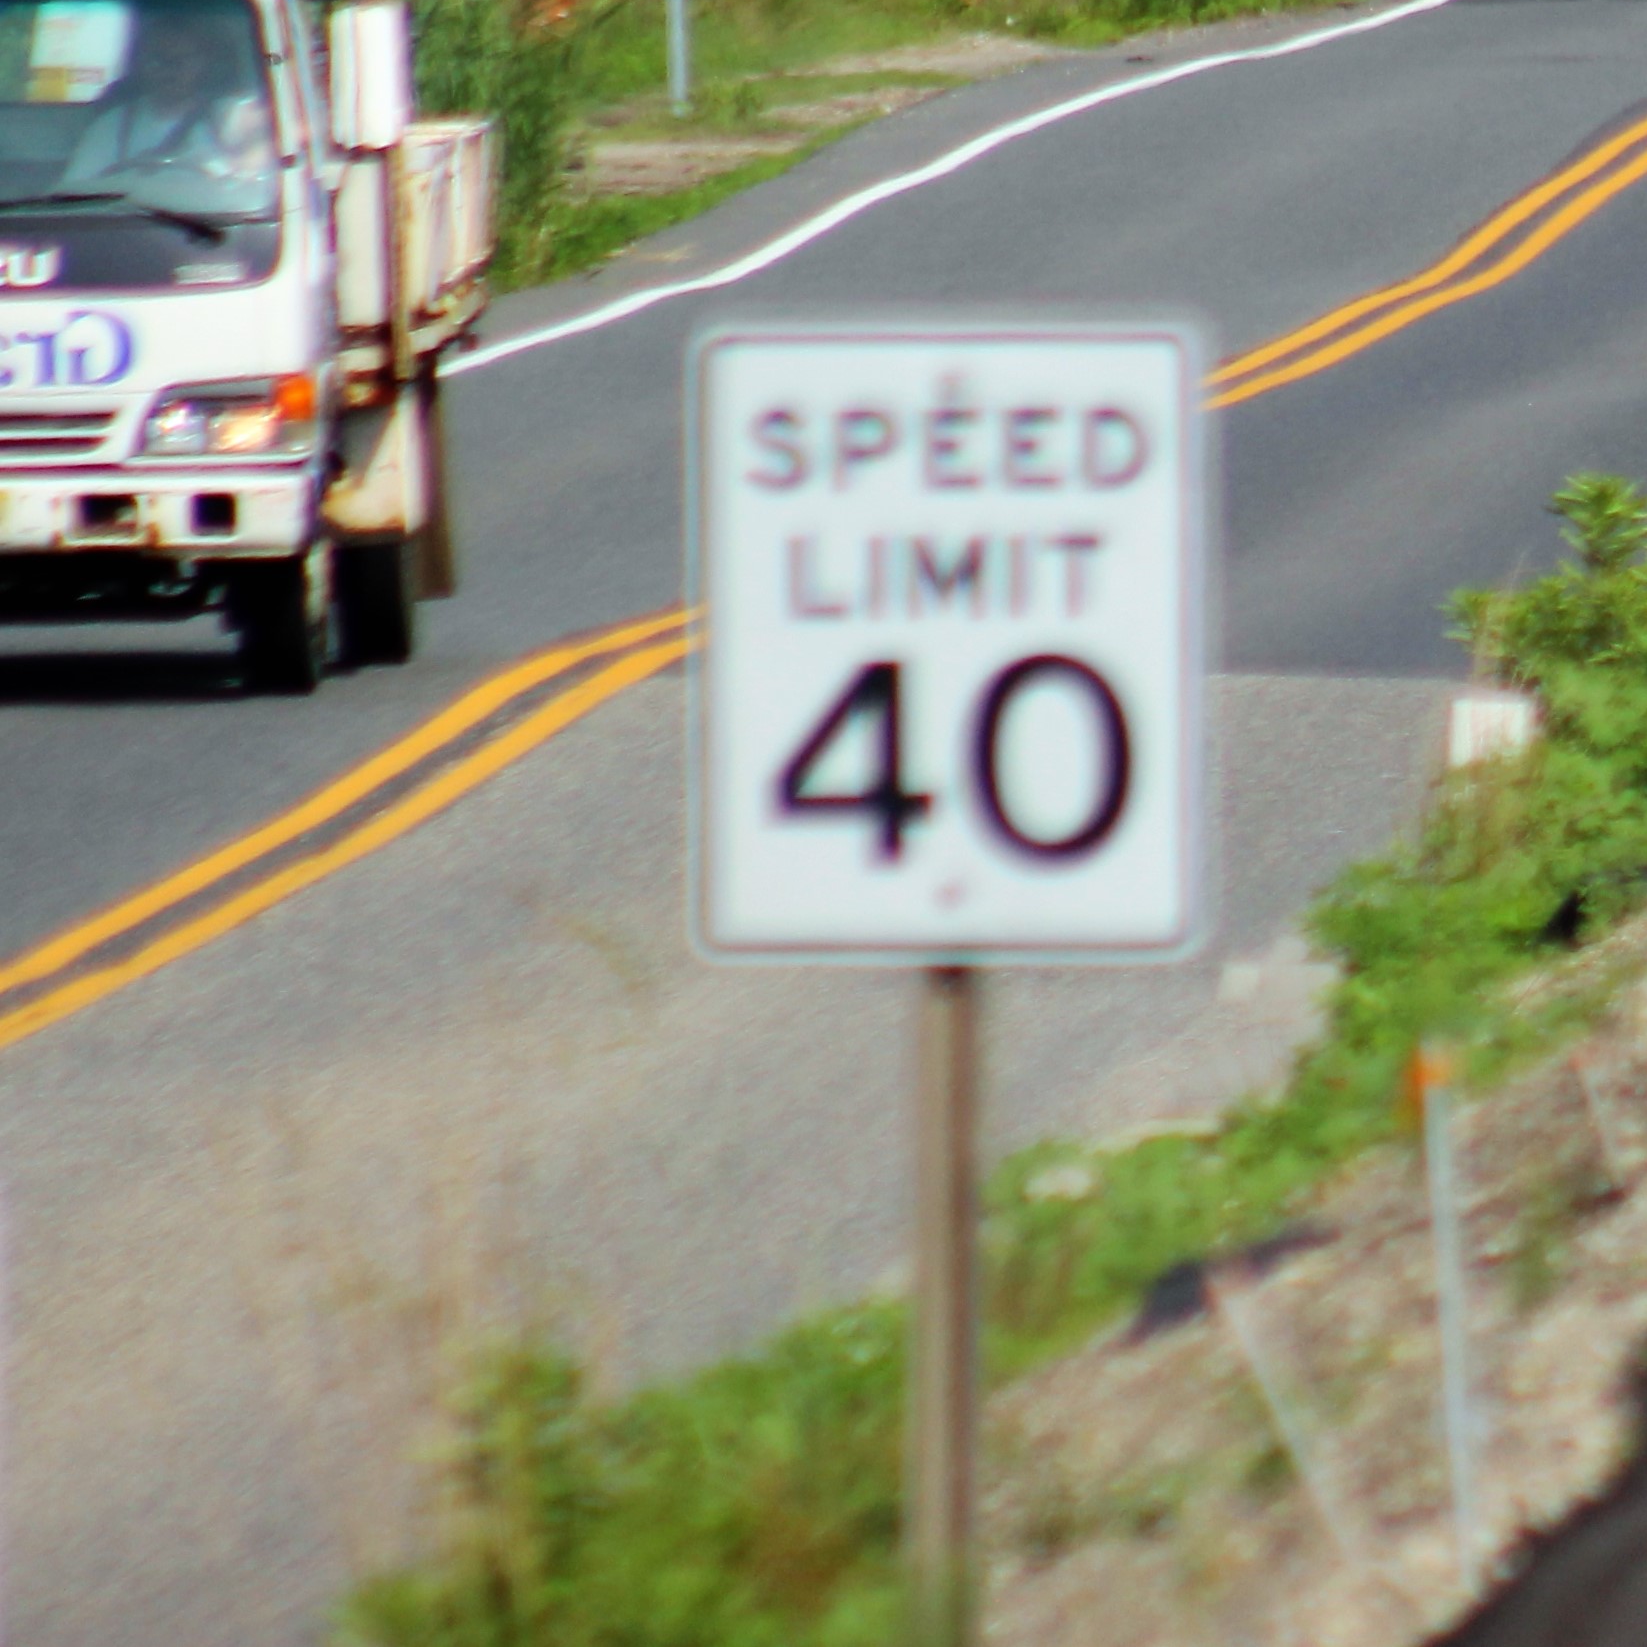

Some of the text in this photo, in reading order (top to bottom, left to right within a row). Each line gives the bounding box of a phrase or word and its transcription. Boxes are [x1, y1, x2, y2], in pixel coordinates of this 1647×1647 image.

[745, 404, 1152, 492] SPEED
[785, 532, 1104, 621] LIMIT
[772, 653, 1134, 868] 40
